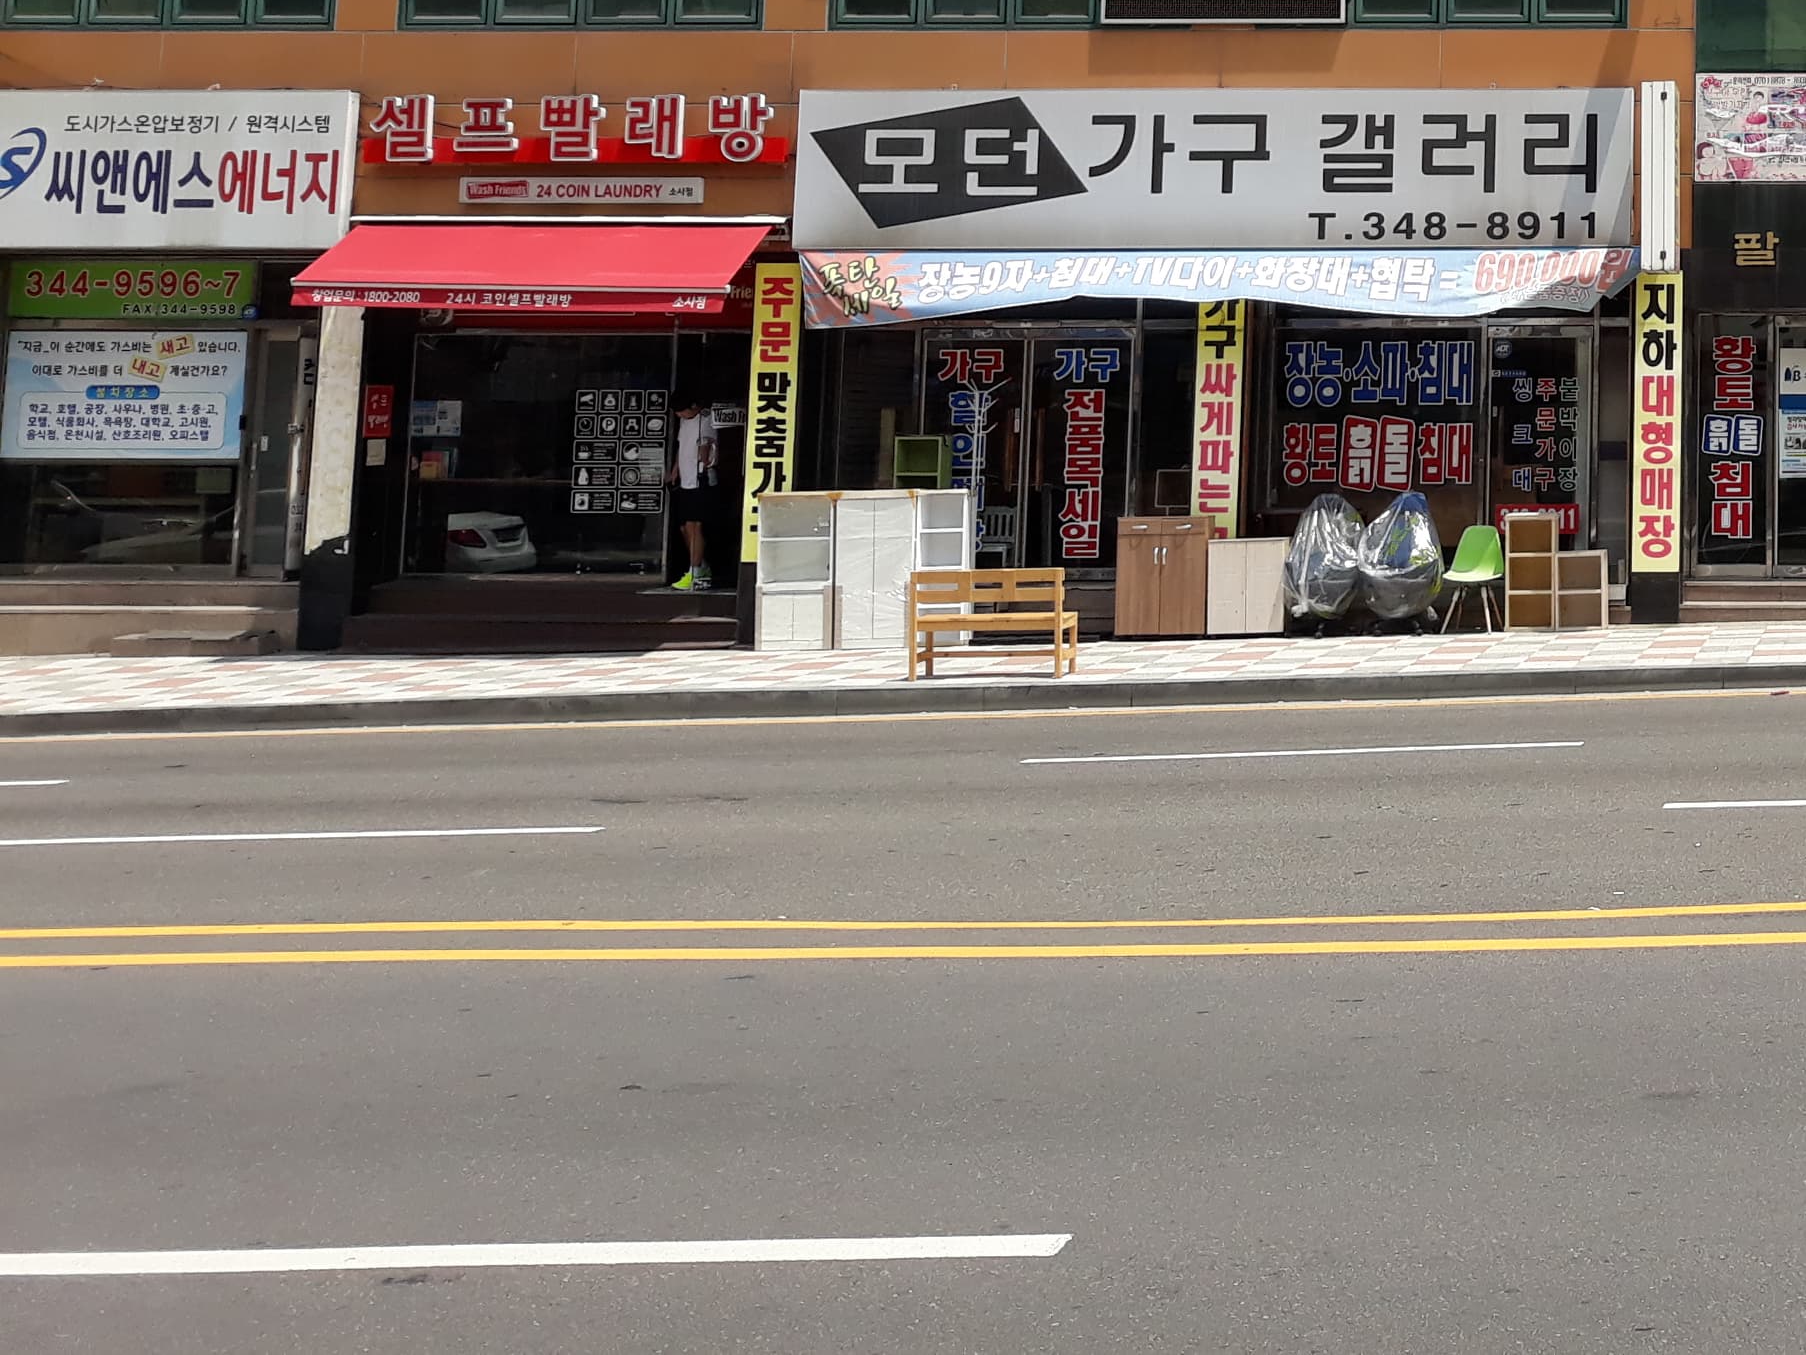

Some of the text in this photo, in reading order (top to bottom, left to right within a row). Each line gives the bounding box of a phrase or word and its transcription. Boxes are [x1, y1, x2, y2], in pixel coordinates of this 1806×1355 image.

[64, 115, 219, 134] 도시가스온압보정기
[246, 115, 330, 134] 원격시스템
[858, 113, 1598, 196] 모던 가구 갤러리
[467, 183, 493, 198] Wash
[536, 185, 553, 198] 24
[556, 184, 591, 199] COIN
[595, 184, 663, 199] LAUNDRY
[1308, 212, 1597, 240] T.348-8911
[25, 270, 242, 298] 344-9596~7
[363, 291, 707, 310] 1800-2080 24시 코인셀프빨래방 소사점
[64, 341, 106, 353] 순간에도
[111, 340, 151, 353] 가스비는
[159, 336, 190, 354] 새고
[32, 364, 63, 376] 이대로
[113, 365, 123, 376] 더
[131, 357, 161, 378] 내고
[938, 349, 1004, 383] 가구
[1053, 348, 1120, 383] 가구
